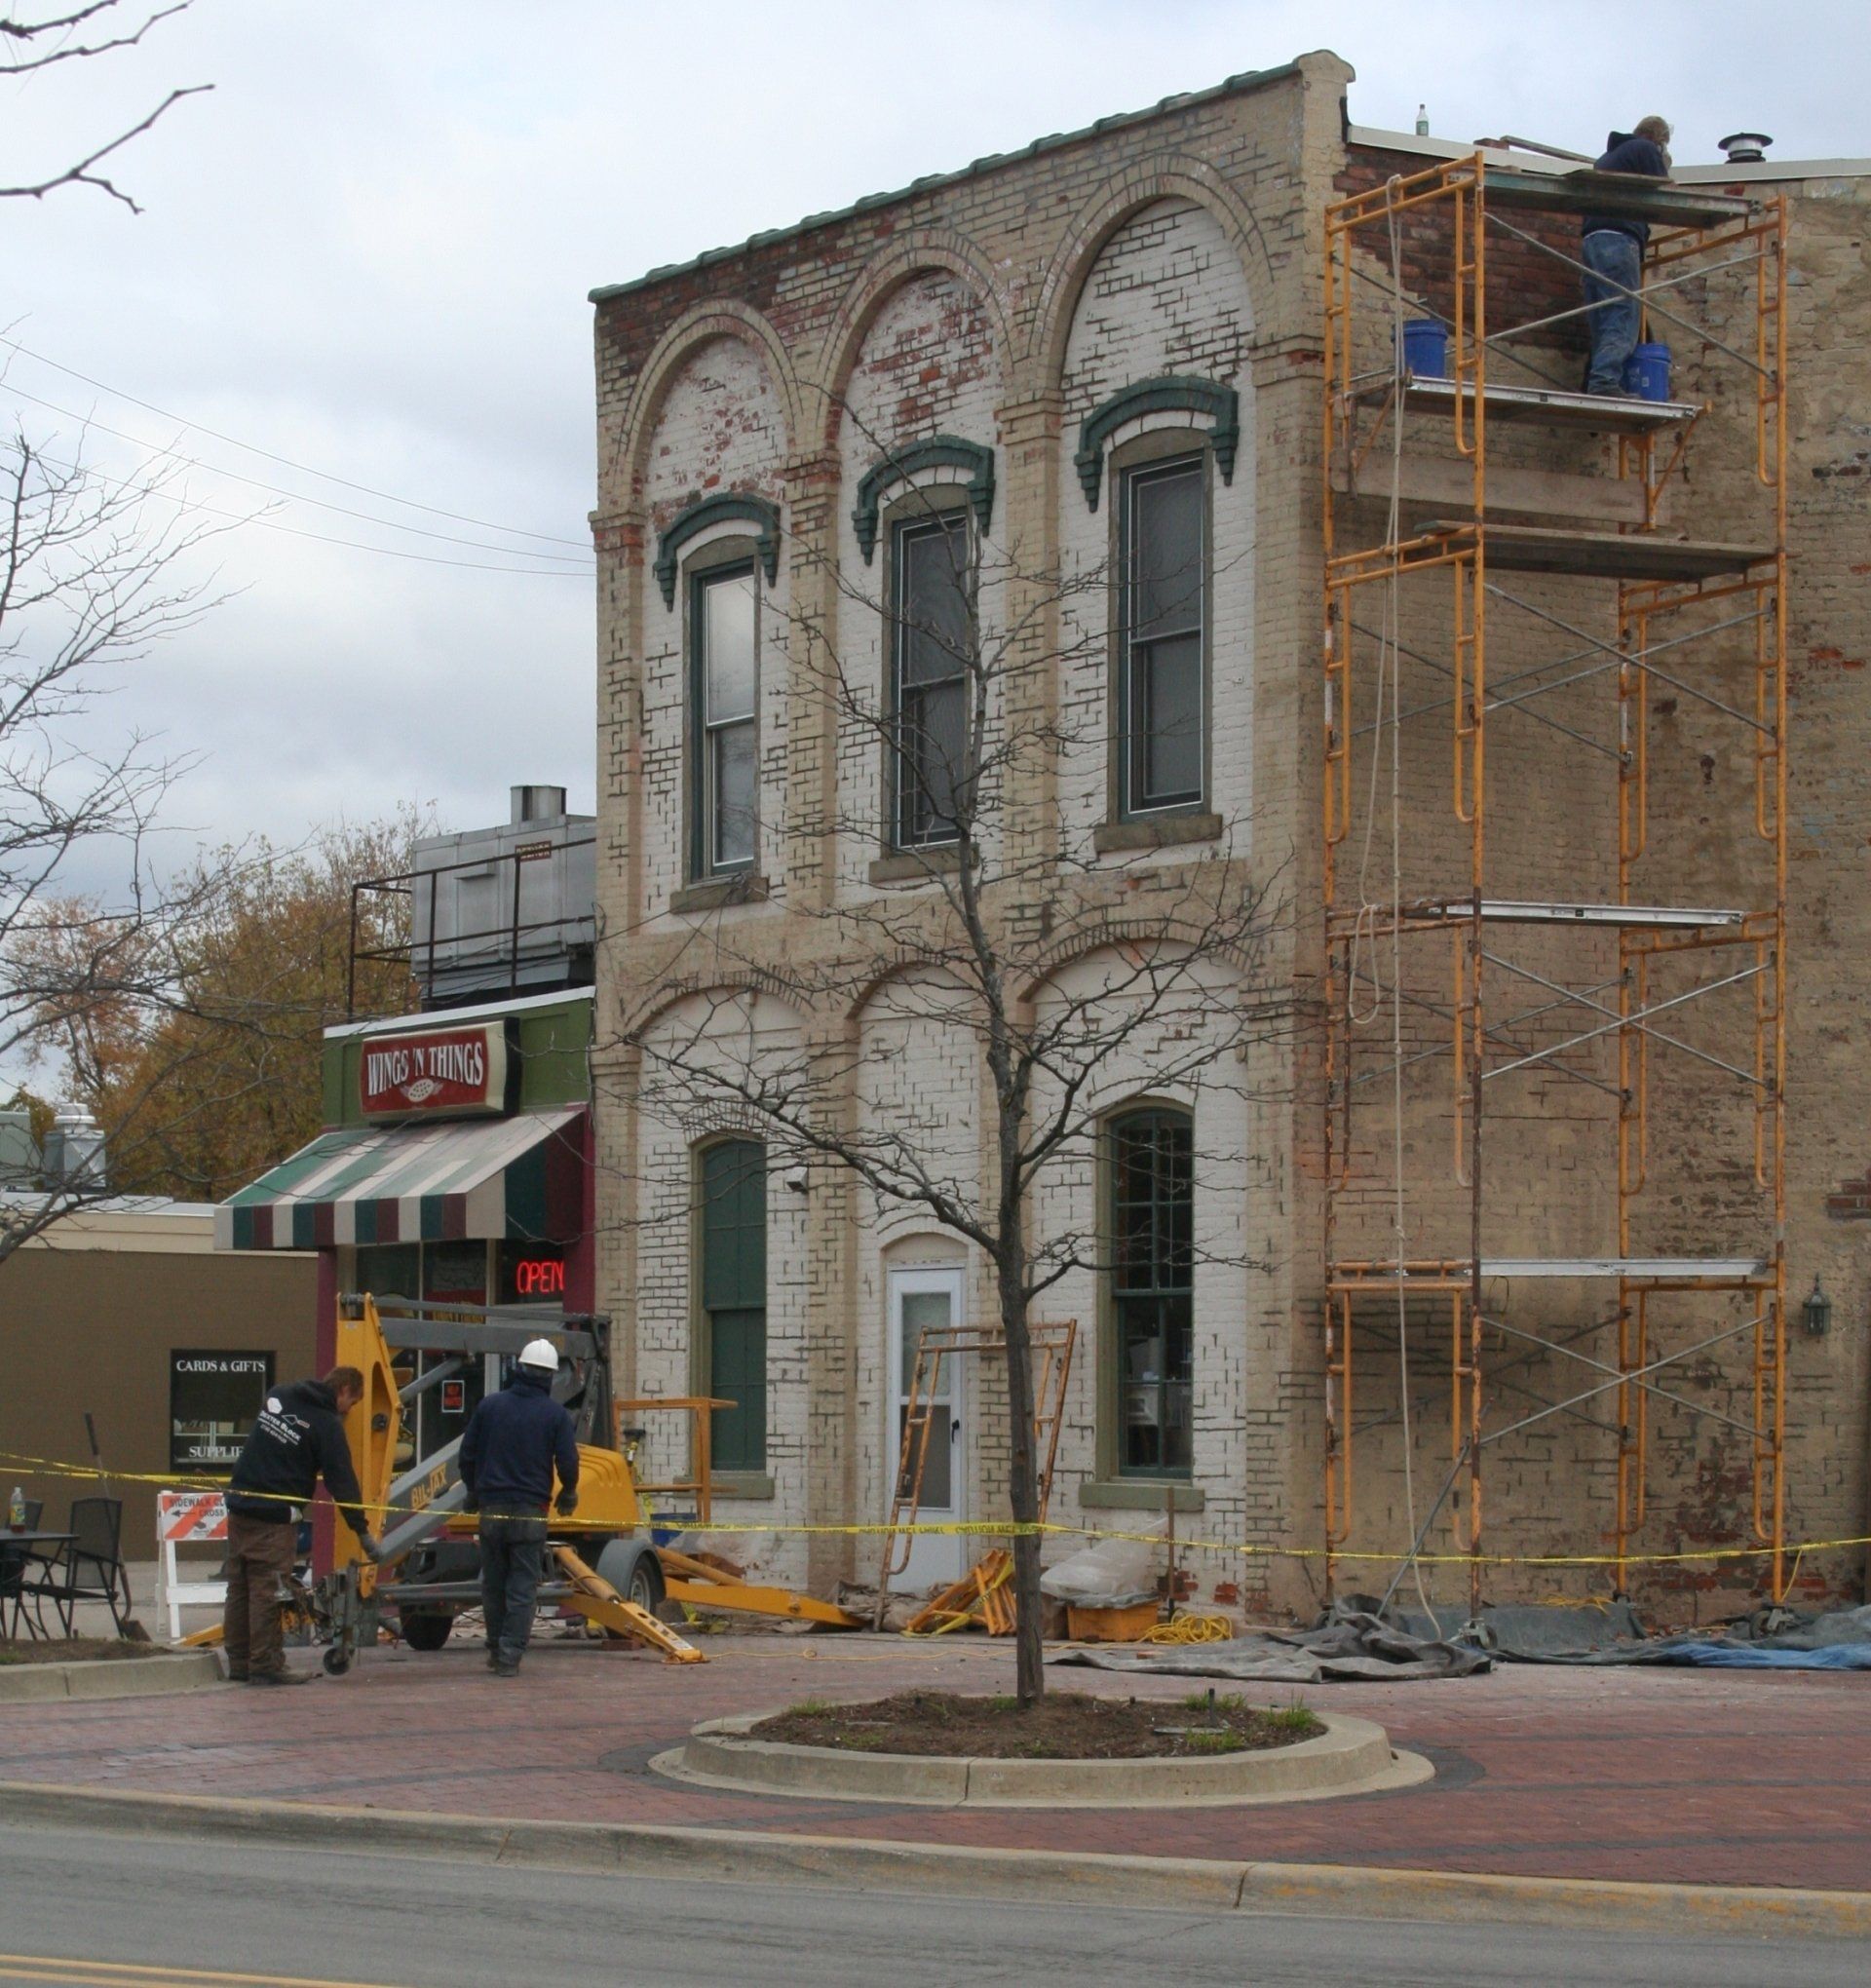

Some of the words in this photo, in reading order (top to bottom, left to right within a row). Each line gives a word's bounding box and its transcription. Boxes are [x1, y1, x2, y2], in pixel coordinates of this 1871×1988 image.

[367, 1050, 408, 1096] WINGS
[429, 1042, 483, 1087] THINGS
[516, 1261, 564, 1294] OPEN
[176, 1360, 217, 1372] CARDS
[219, 1361, 228, 1372] &
[230, 1360, 266, 1372] GIFTS
[188, 1445, 245, 1458] SUPPLIE
[169, 1496, 210, 1508] SIDEWALK
